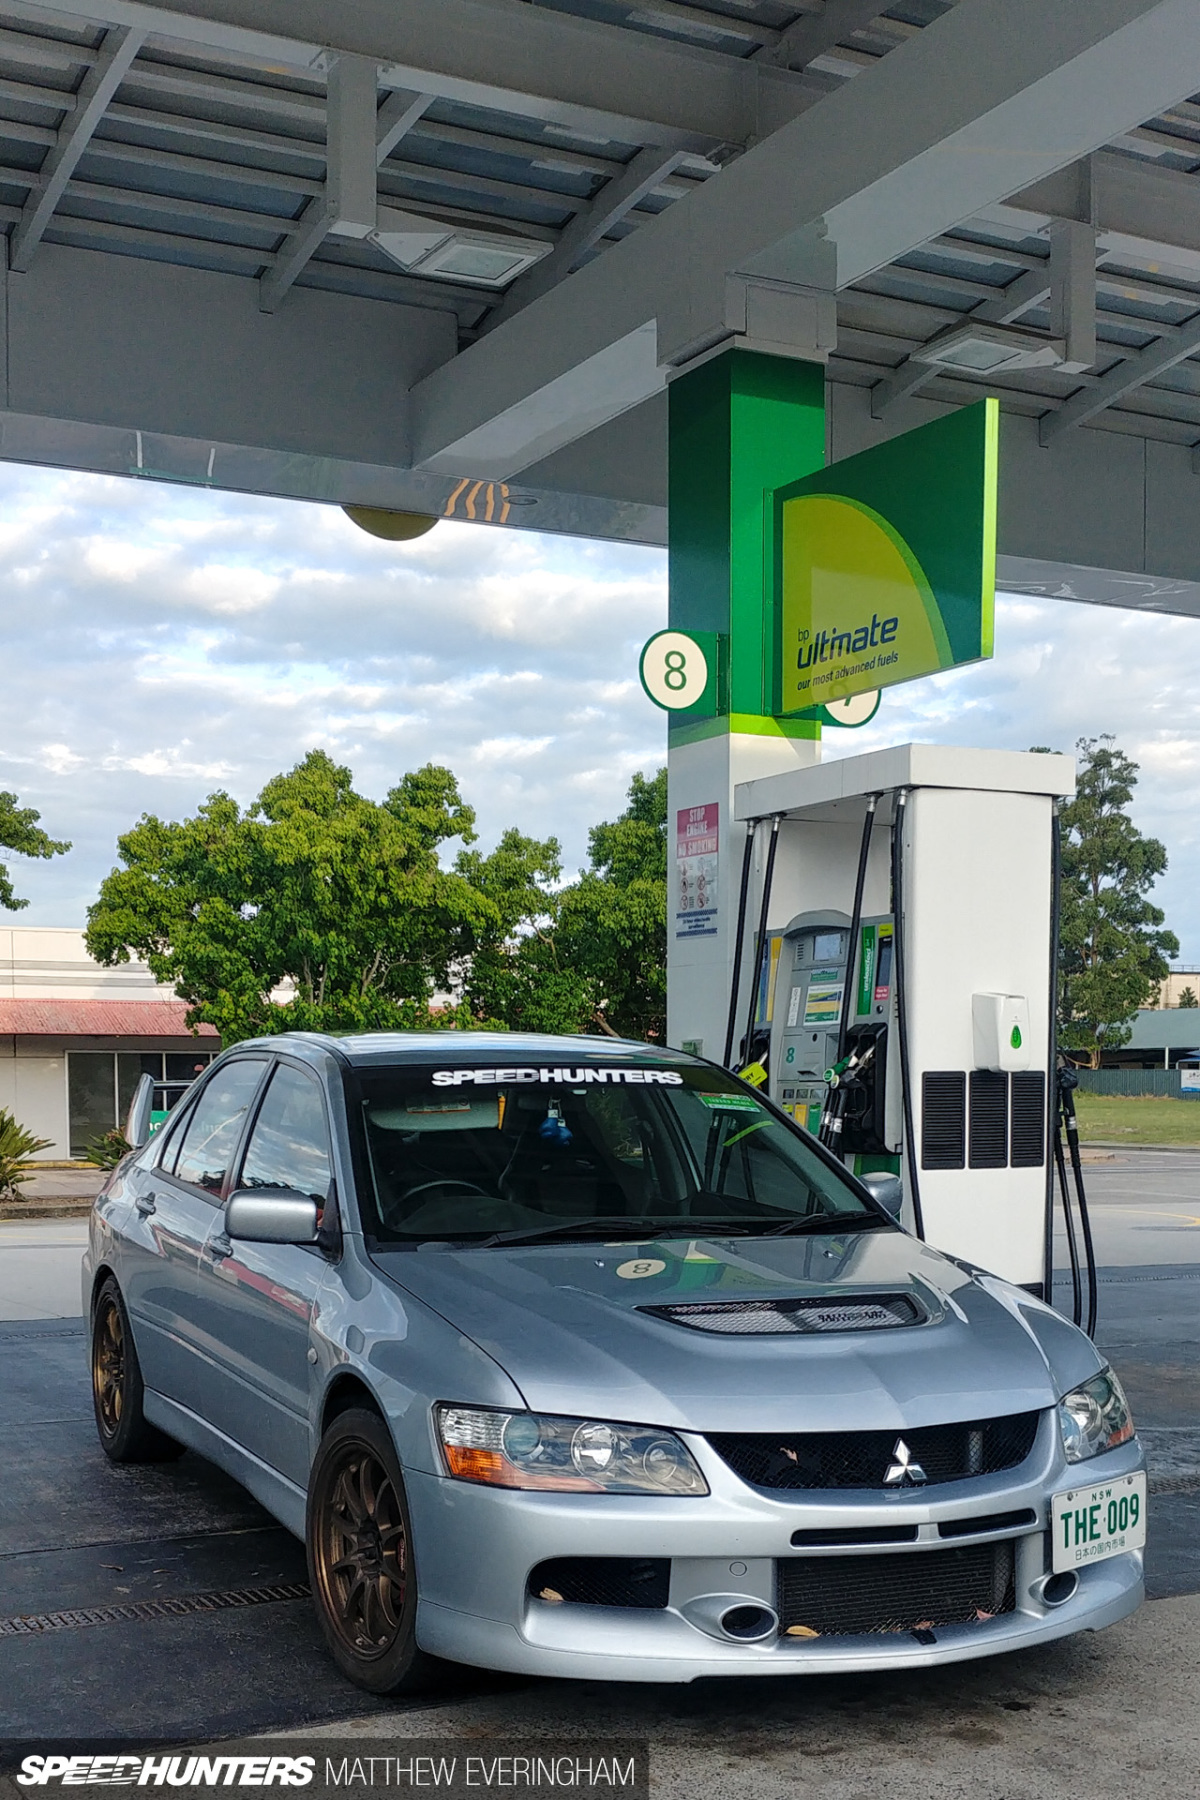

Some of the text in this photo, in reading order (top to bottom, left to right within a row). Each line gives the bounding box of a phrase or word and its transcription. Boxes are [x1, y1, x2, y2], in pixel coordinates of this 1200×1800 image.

[797, 628, 810, 643] bp
[797, 613, 899, 669] ultimate
[664, 650, 687, 691] 8
[797, 651, 899, 690] our most advanced fuels
[689, 807, 706, 823] STOP
[687, 820, 708, 837] ENGINE
[678, 838, 717, 857] NO SMOKING
[786, 1047, 795, 1064] 8
[431, 1068, 684, 1085] SPEEDHUNTERS
[1091, 1488, 1113, 1502] NSW
